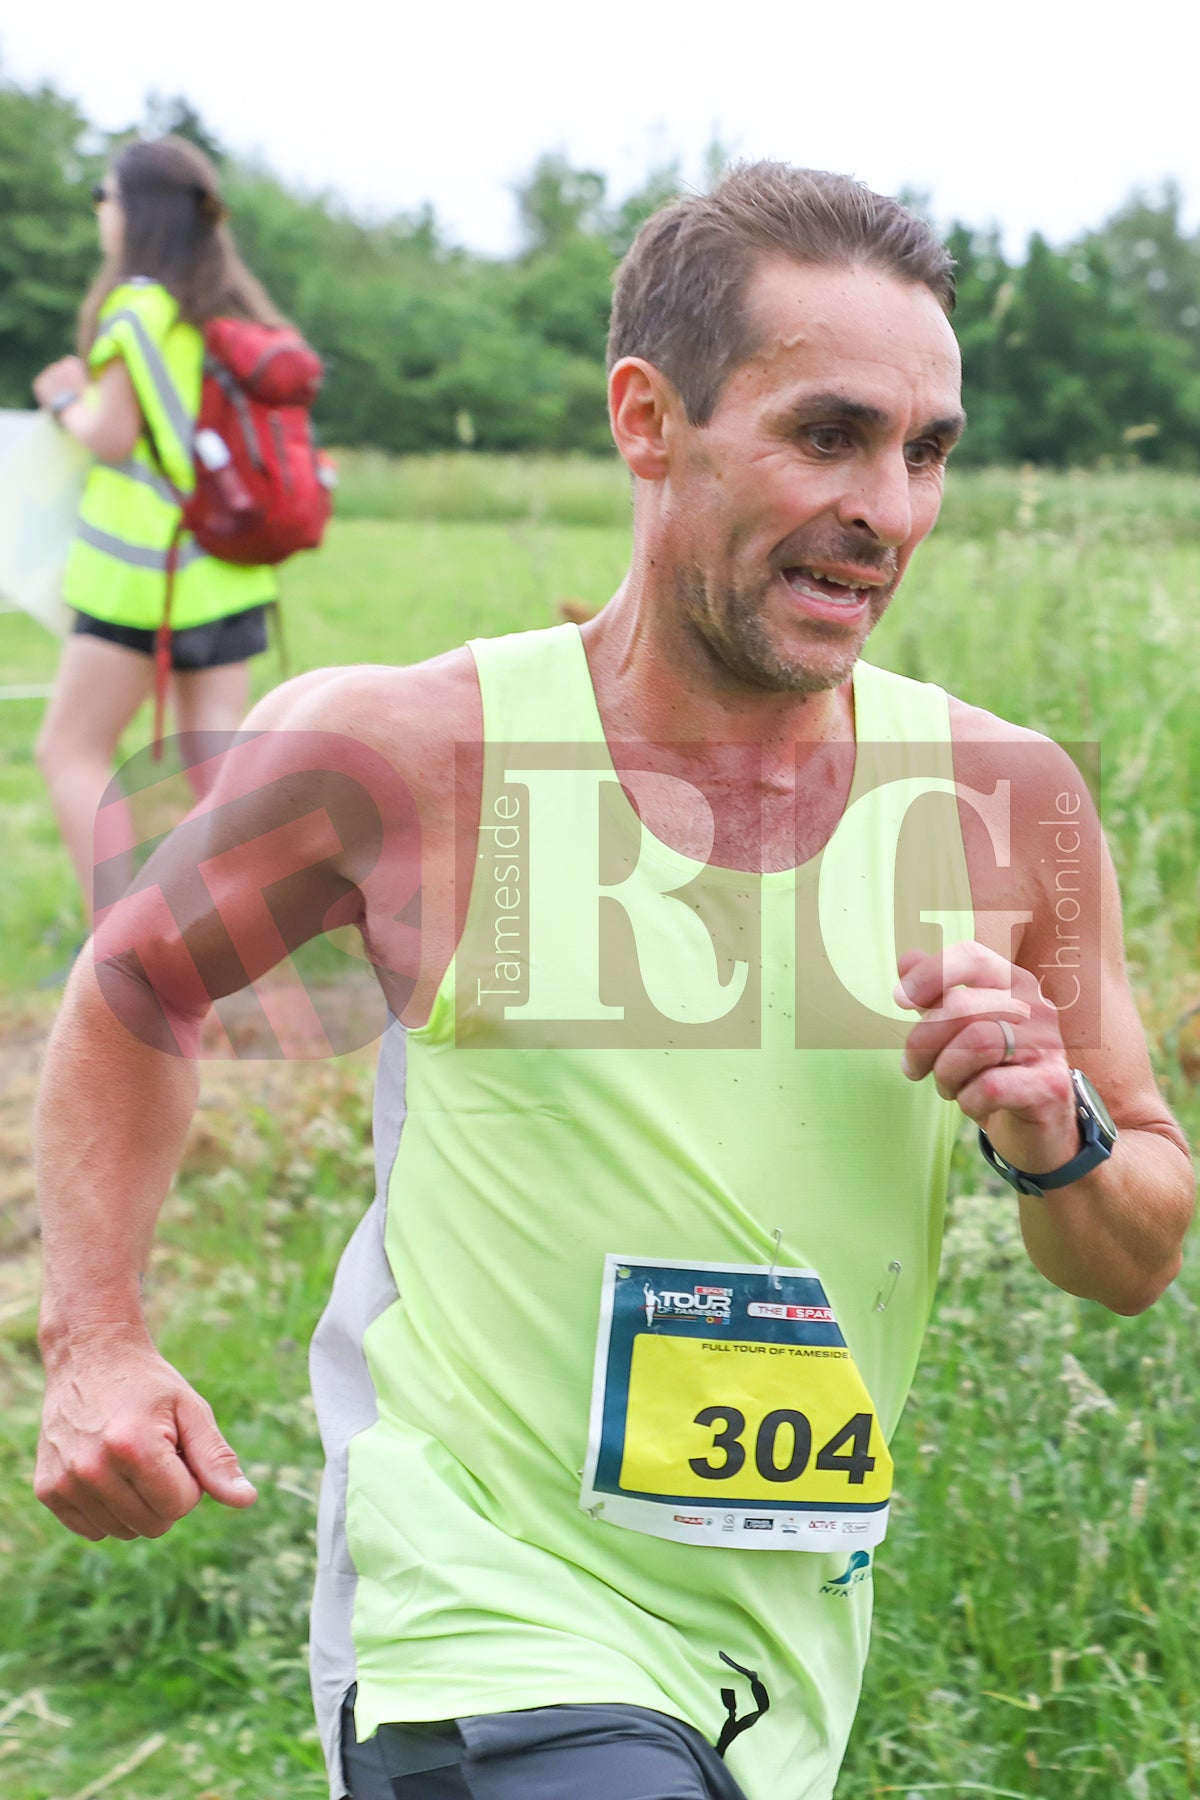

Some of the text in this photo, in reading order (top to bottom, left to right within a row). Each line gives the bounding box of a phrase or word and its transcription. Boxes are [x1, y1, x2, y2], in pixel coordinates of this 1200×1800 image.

[658, 1291, 732, 1311] TOUR
[757, 1305, 833, 1320] THE SPAR
[702, 1343, 849, 1359] FULL TOUR OF TAMESIDE
[688, 1405, 876, 1485] 304
